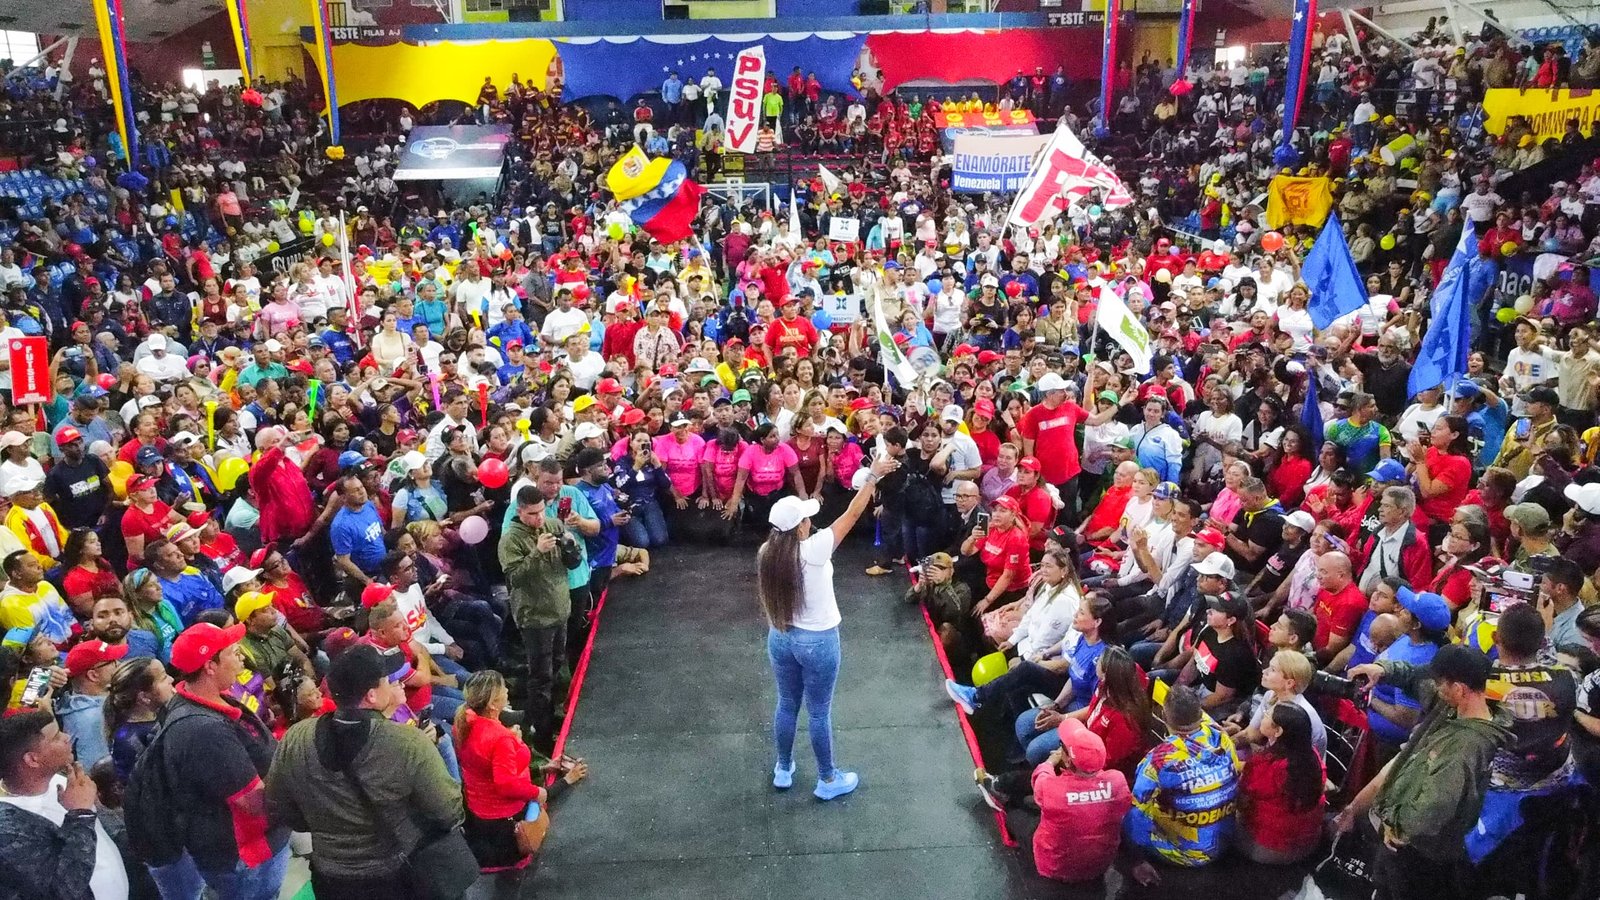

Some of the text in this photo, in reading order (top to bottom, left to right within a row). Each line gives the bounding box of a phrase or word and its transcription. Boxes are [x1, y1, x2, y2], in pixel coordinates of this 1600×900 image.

[1060, 12, 1084, 25] ESTE
[1088, 14, 1104, 22] FILA
[334, 27, 358, 39] ESTE
[955, 153, 1032, 173] ENAMÓRATE
[954, 174, 1001, 190] Venezuela
